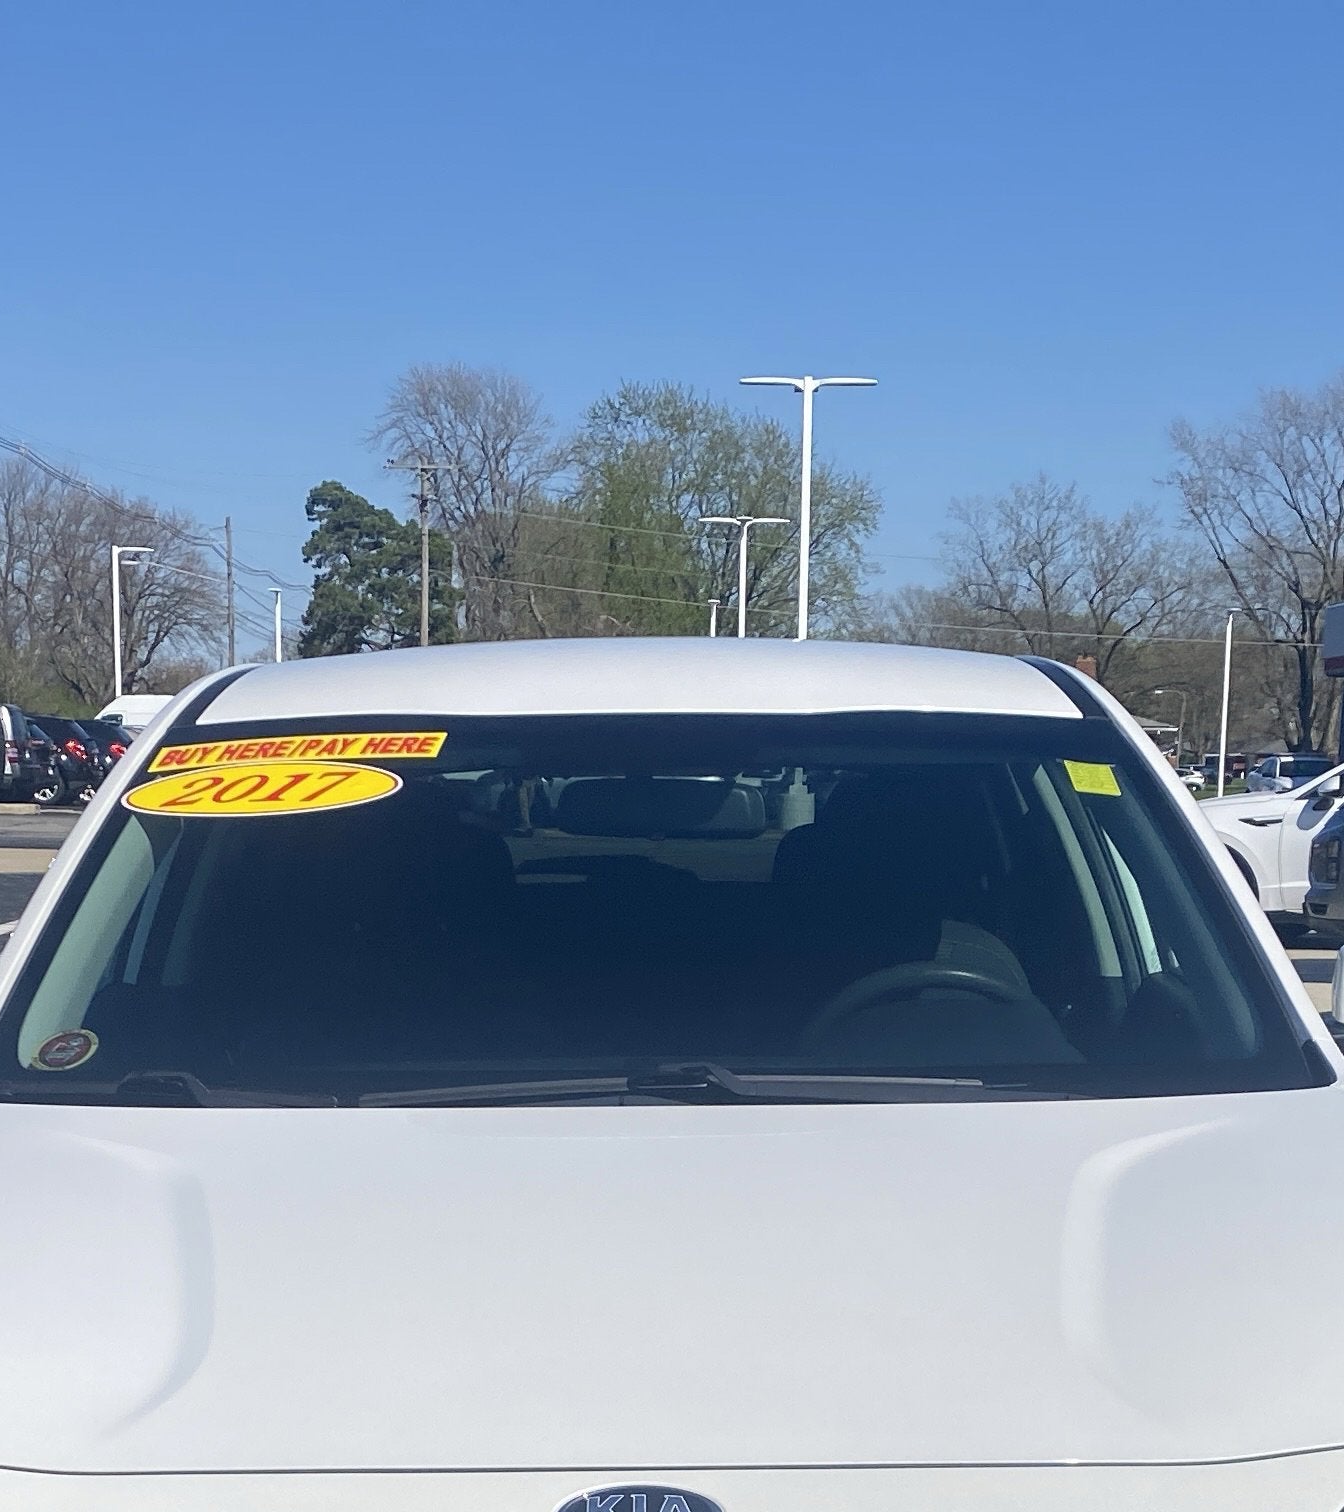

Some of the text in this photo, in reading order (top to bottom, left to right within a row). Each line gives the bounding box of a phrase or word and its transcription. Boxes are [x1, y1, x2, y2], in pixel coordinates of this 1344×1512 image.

[157, 736, 439, 767] BUY HERE/PAY HERE
[159, 770, 360, 808] 2017
